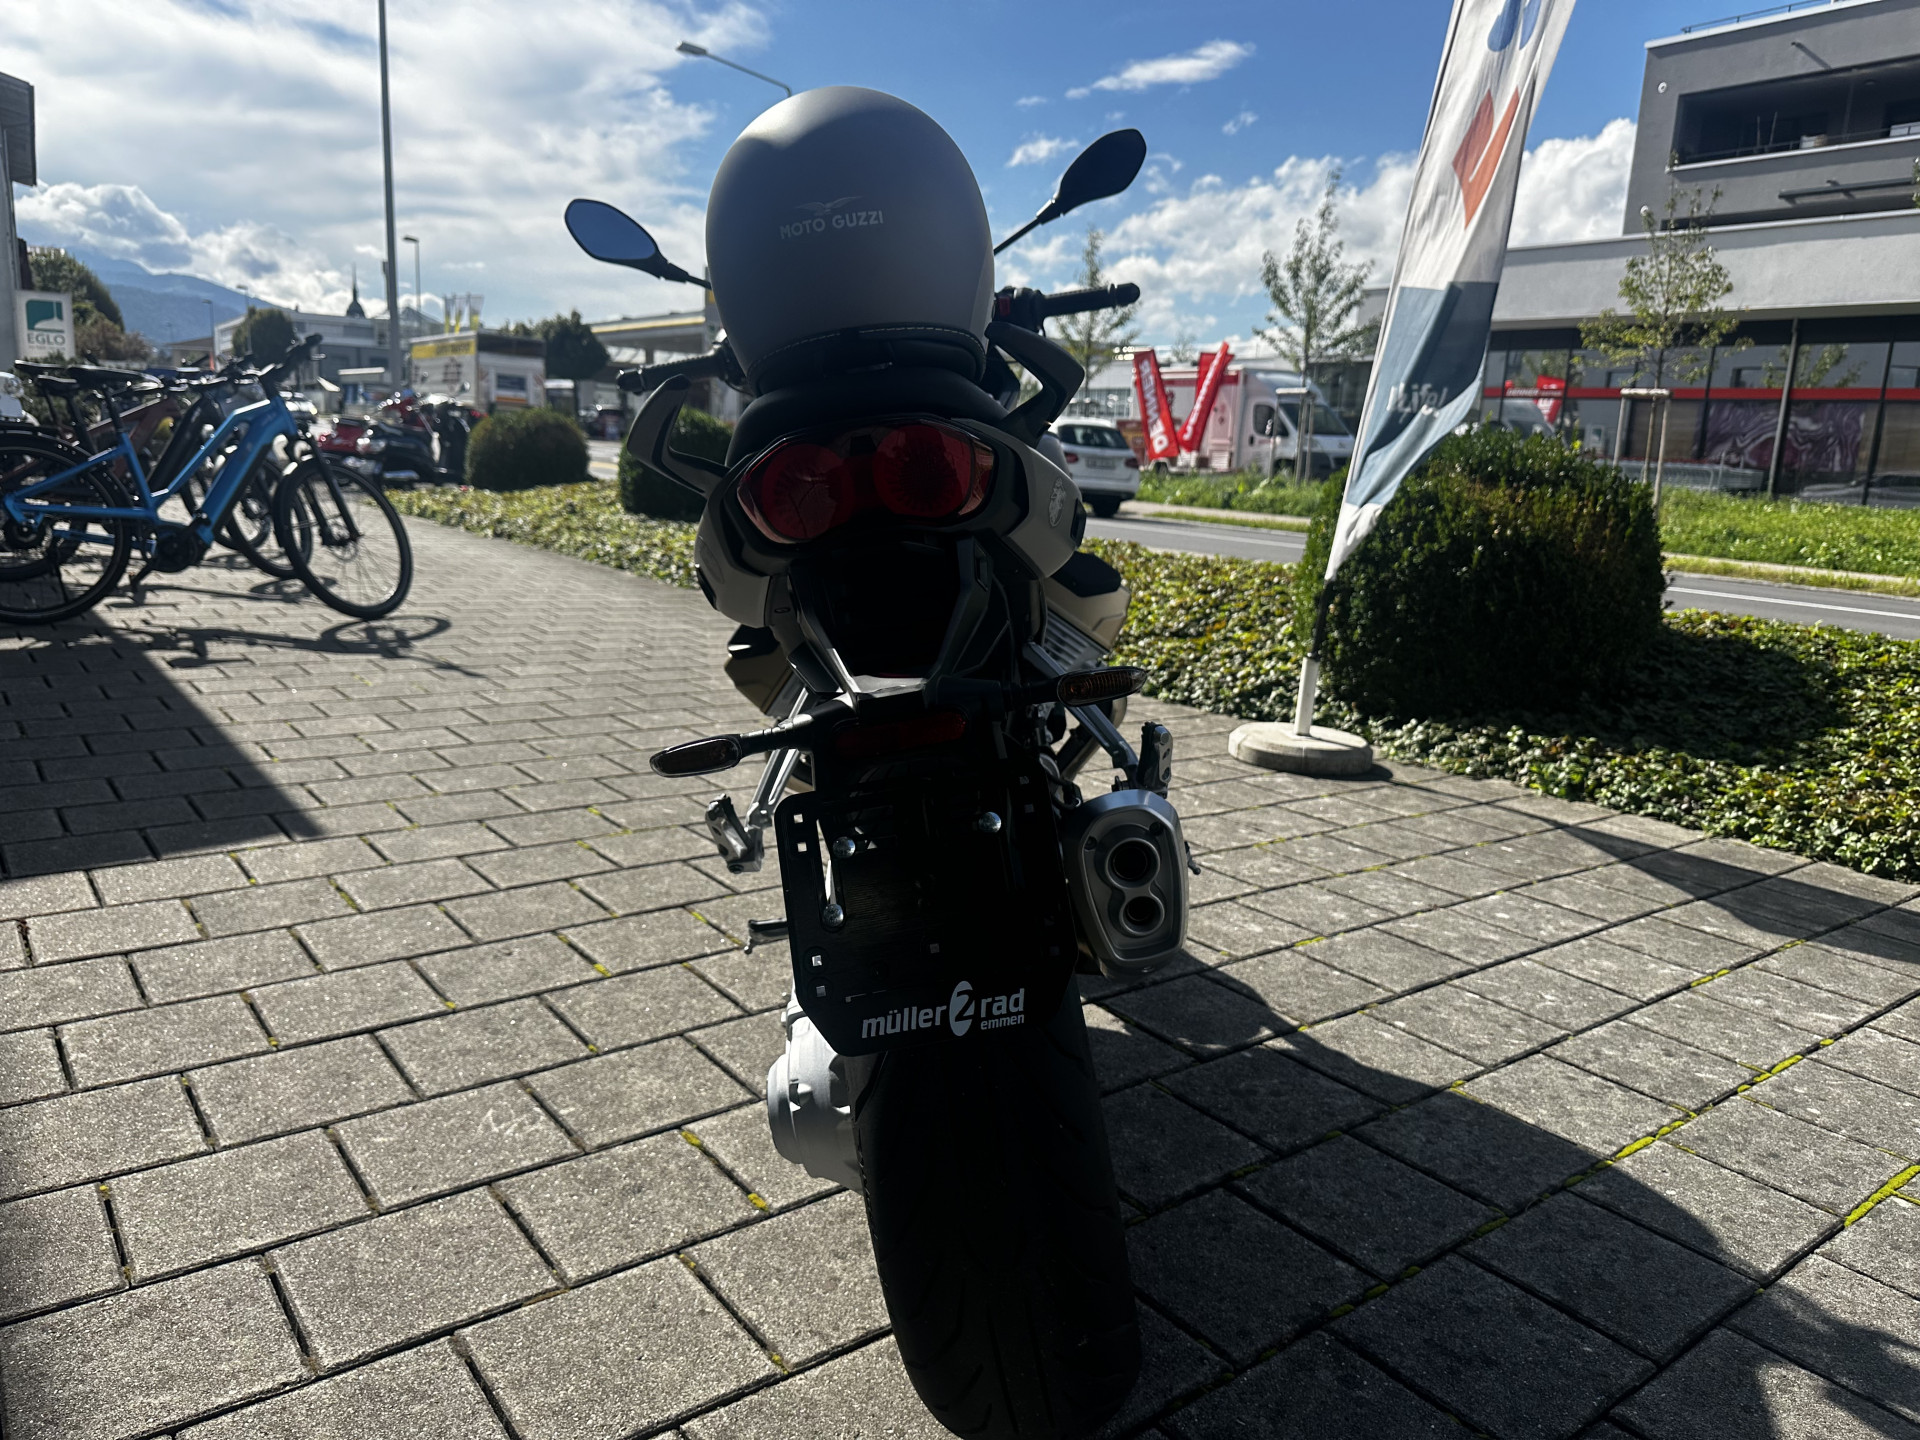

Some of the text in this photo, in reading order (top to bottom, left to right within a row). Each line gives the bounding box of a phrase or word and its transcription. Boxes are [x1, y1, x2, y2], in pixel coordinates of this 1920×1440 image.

[780, 210, 883, 239] MOTO GUZZI
[27, 333, 66, 346] EGLO
[861, 1005, 947, 1039] müller
[980, 987, 1025, 1018] rad
[980, 1014, 1025, 1031] emmen
